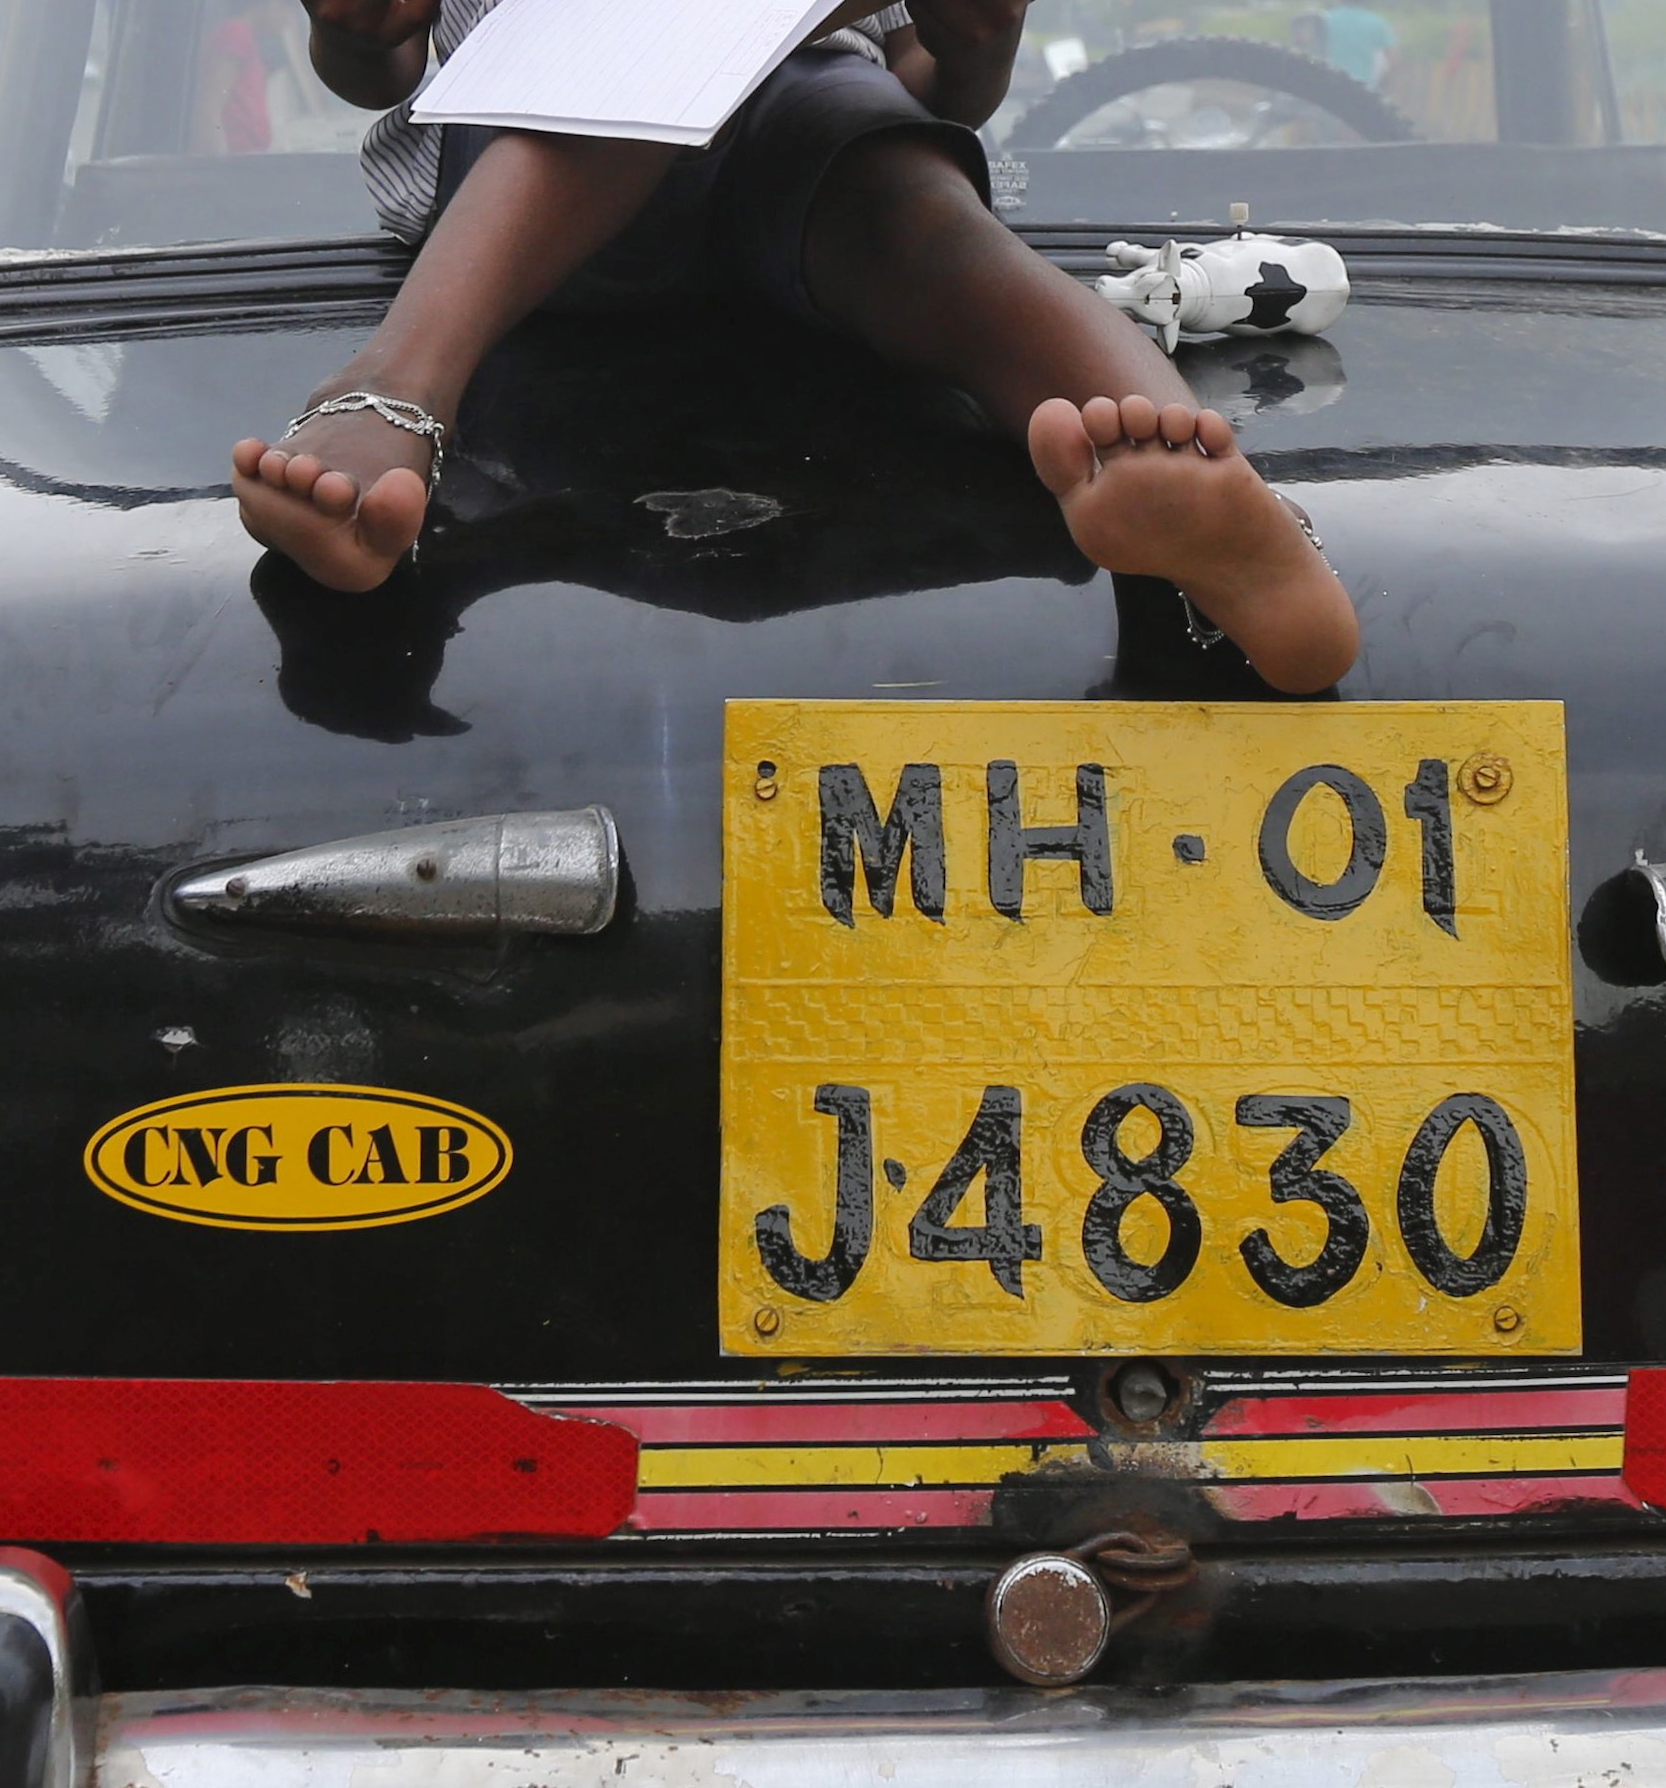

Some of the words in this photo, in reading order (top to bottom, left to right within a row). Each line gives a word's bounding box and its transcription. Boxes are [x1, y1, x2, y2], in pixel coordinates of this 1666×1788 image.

[818, 759, 1114, 928] MH
[1258, 758, 1459, 941] 01
[123, 1123, 283, 1189] CNG
[307, 1123, 471, 1187] CAB
